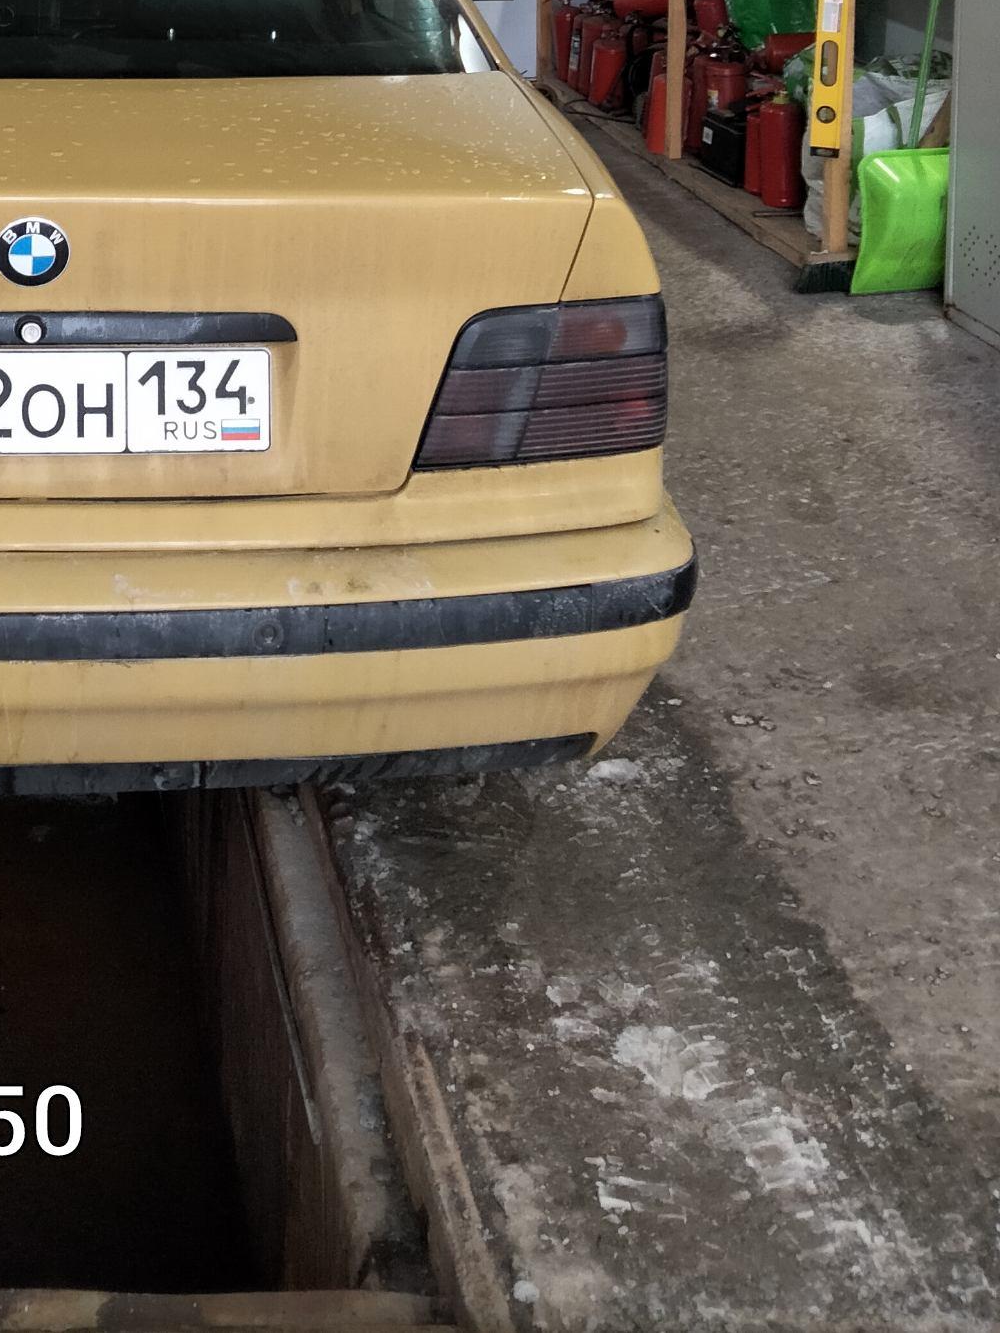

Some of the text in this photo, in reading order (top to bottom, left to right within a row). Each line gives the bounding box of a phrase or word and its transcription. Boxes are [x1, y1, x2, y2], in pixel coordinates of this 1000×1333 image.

[2, 221, 64, 245] BMW
[138, 359, 248, 416] 134
[164, 421, 217, 440] RUS
